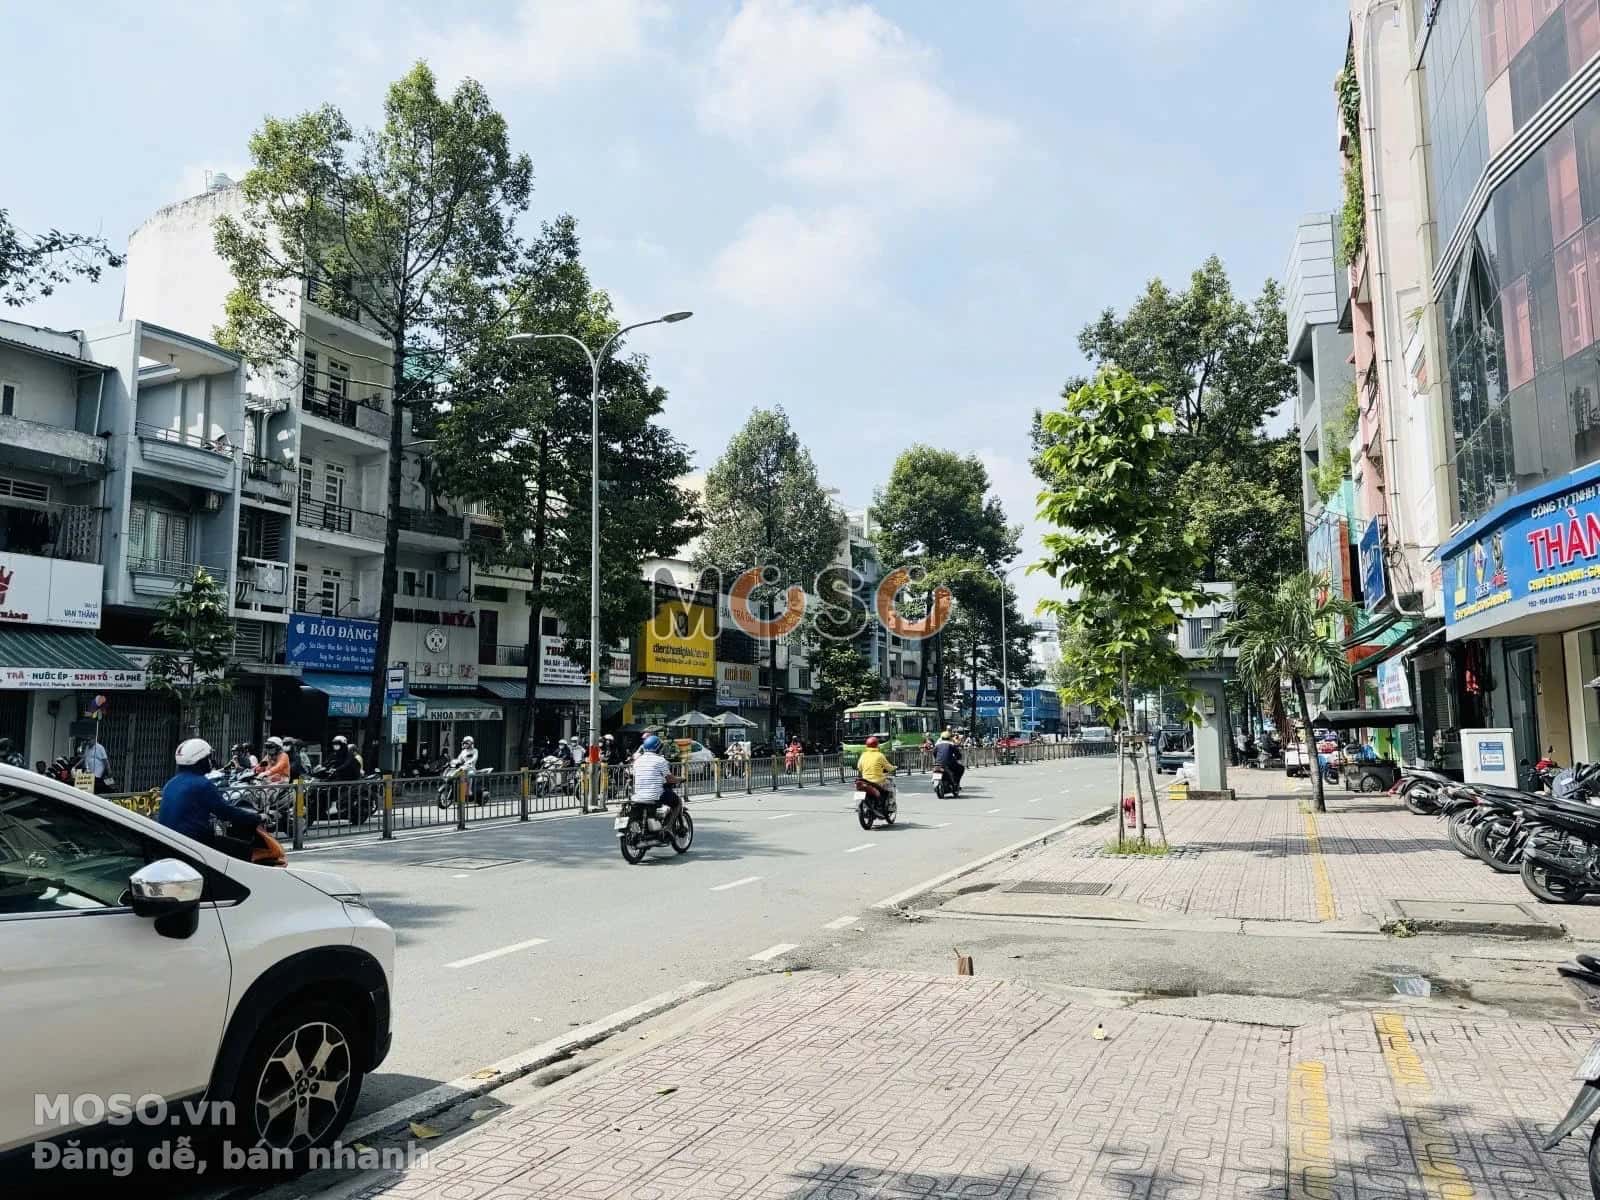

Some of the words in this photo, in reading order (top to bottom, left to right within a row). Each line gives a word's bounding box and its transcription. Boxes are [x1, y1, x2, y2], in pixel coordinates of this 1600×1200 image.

[1531, 501, 1556, 518] CÔNG
[1557, 495, 1571, 509] TY
[1570, 486, 1596, 504] TNHH
[310, 620, 335, 637] BẢO
[337, 625, 372, 642] ĐẶNG
[6, 671, 25, 680] TRÀ
[74, 673, 96, 681] SINH
[97, 671, 109, 681] TỐ
[431, 711, 453, 720] KHOA
